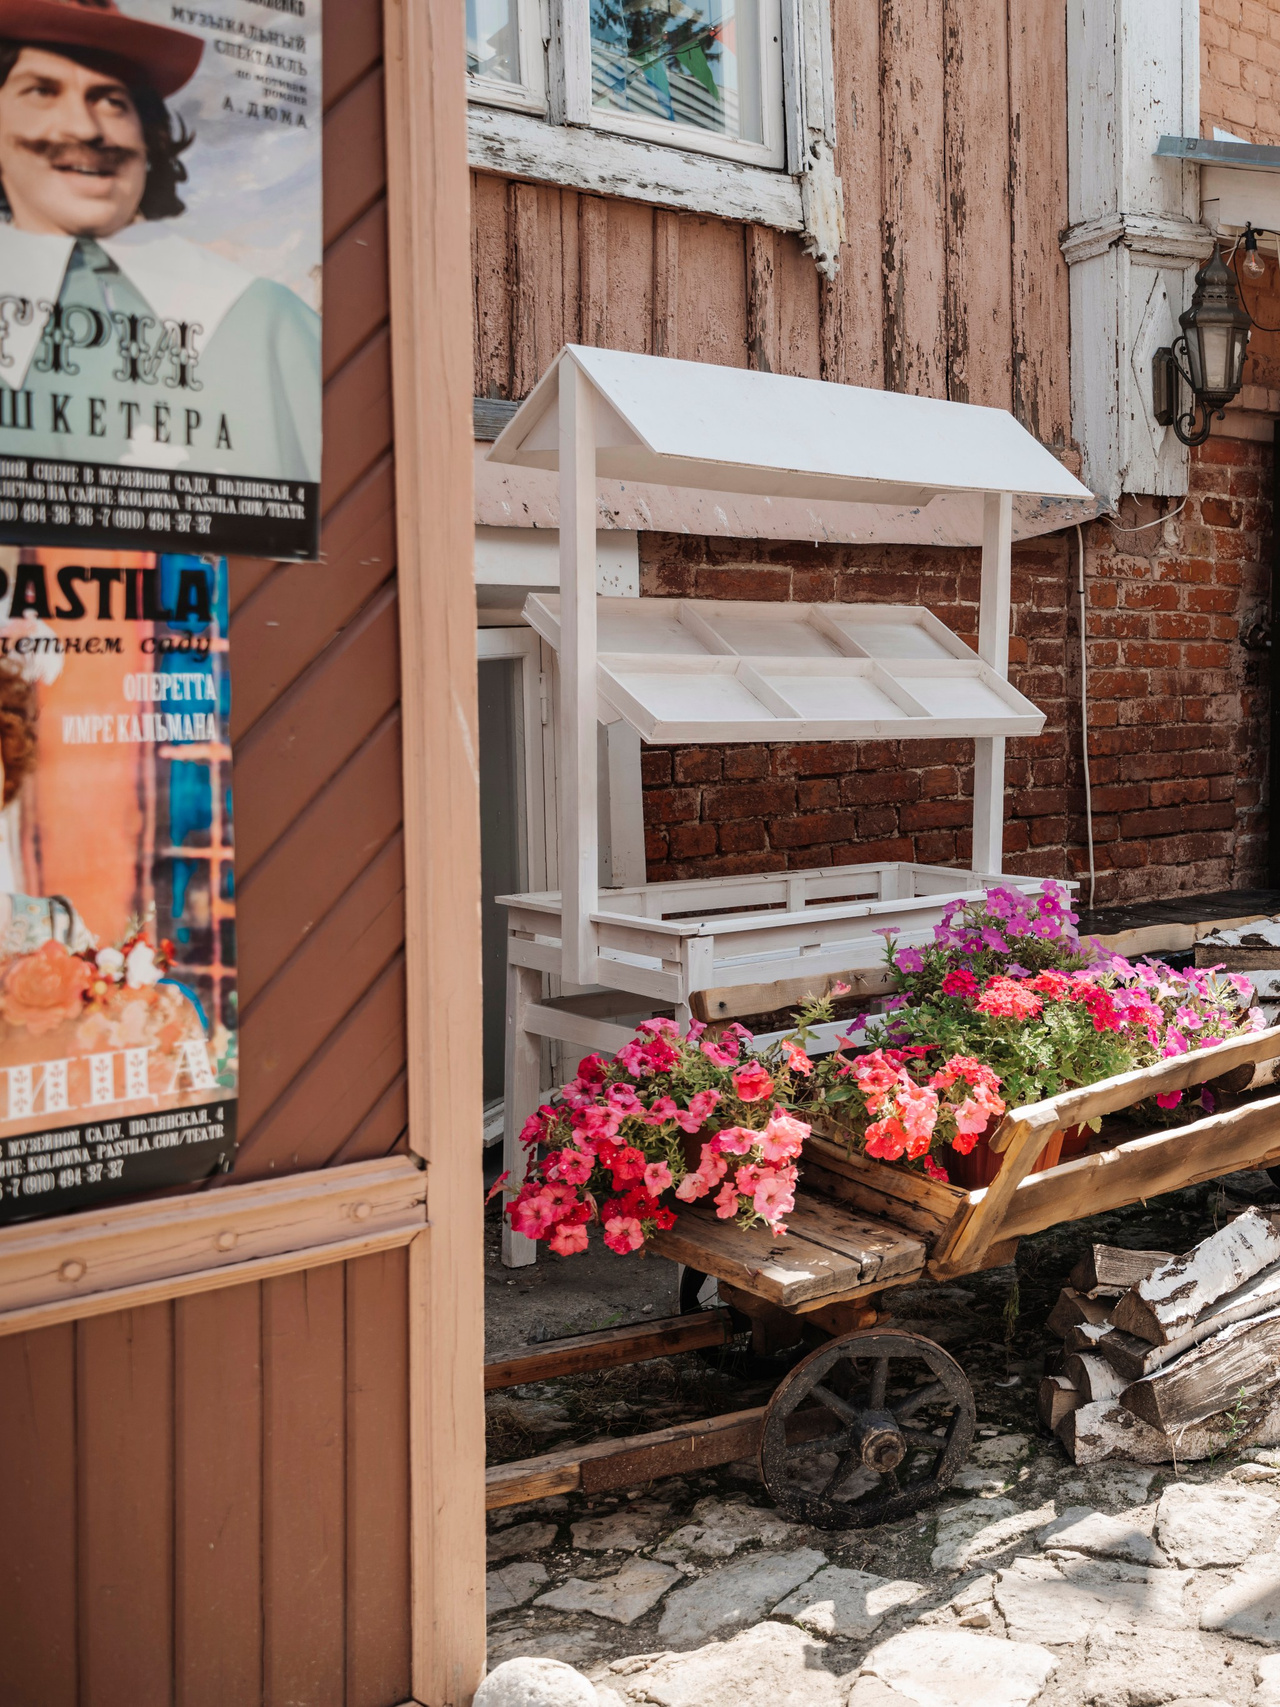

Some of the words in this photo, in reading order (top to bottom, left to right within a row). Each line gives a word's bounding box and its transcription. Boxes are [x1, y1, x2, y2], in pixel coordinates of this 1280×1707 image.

[171, 5, 307, 54] МУЗЫКАЛЬНЫЙ
[213, 39, 308, 76] СПЕКТАКЛЬ
[254, 74, 307, 93] мотивам
[263, 88, 307, 106] романа
[0, 387, 233, 450] ШКЕТЁРА
[33, 462, 80, 484] СЦЕНЕ
[83, 466, 95, 485] В
[99, 467, 171, 491] МУЗЕЙНОМ
[295, 486, 305, 502] 4
[47, 482, 68, 502] НА
[112, 508, 145, 530] (910)
[147, 511, 212, 535] 494-37-37
[141, 630, 211, 664] саду
[123, 672, 217, 702] ОПЕРЕТТА
[62, 714, 114, 745] ИМРЕ
[117, 712, 217, 743] КАЛЬМАНА
[8, 1129, 81, 1157] МУЗЕЙНОМ
[215, 1106, 224, 1122] 4
[27, 1124, 225, 1174] KOLOMNA-PASTILA.COM/TEATR
[22, 1172, 55, 1196] (910)
[57, 1159, 124, 1190] 494-37-37
